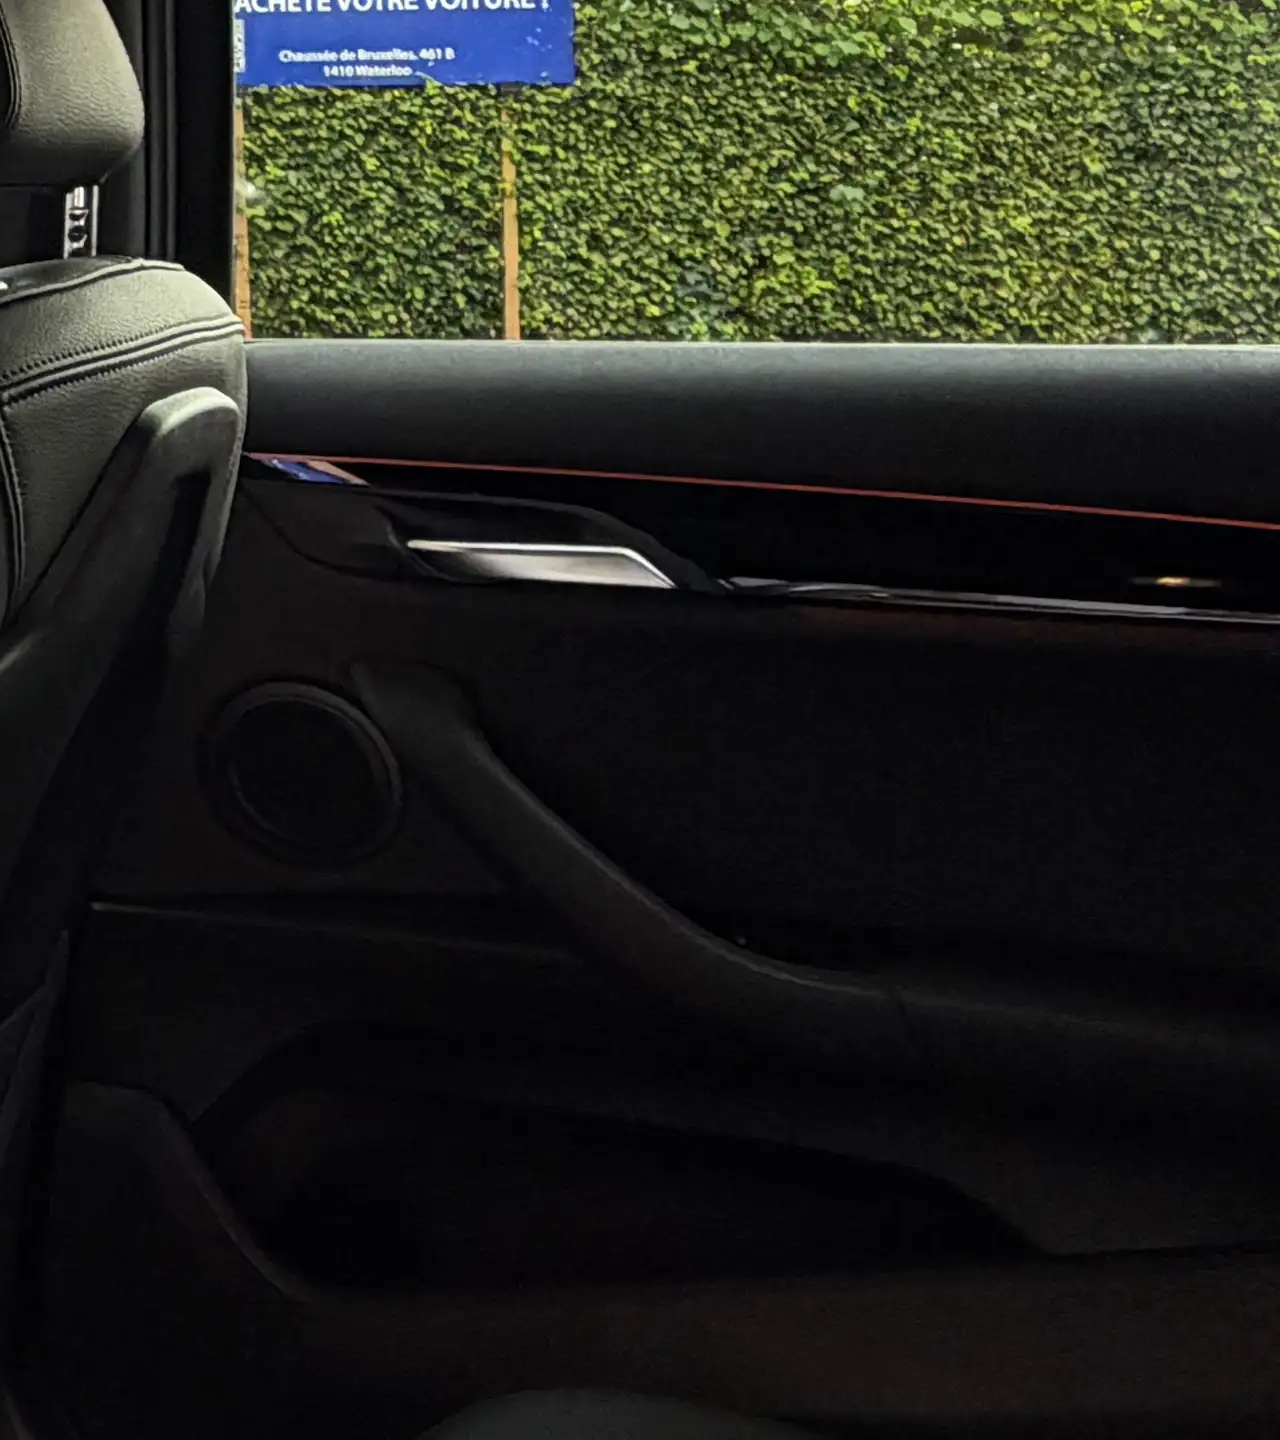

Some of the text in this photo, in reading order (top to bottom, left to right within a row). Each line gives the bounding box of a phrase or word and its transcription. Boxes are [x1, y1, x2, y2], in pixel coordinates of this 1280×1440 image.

[340, 49, 356, 62] de
[324, 64, 413, 78] 1410 Waterloo
